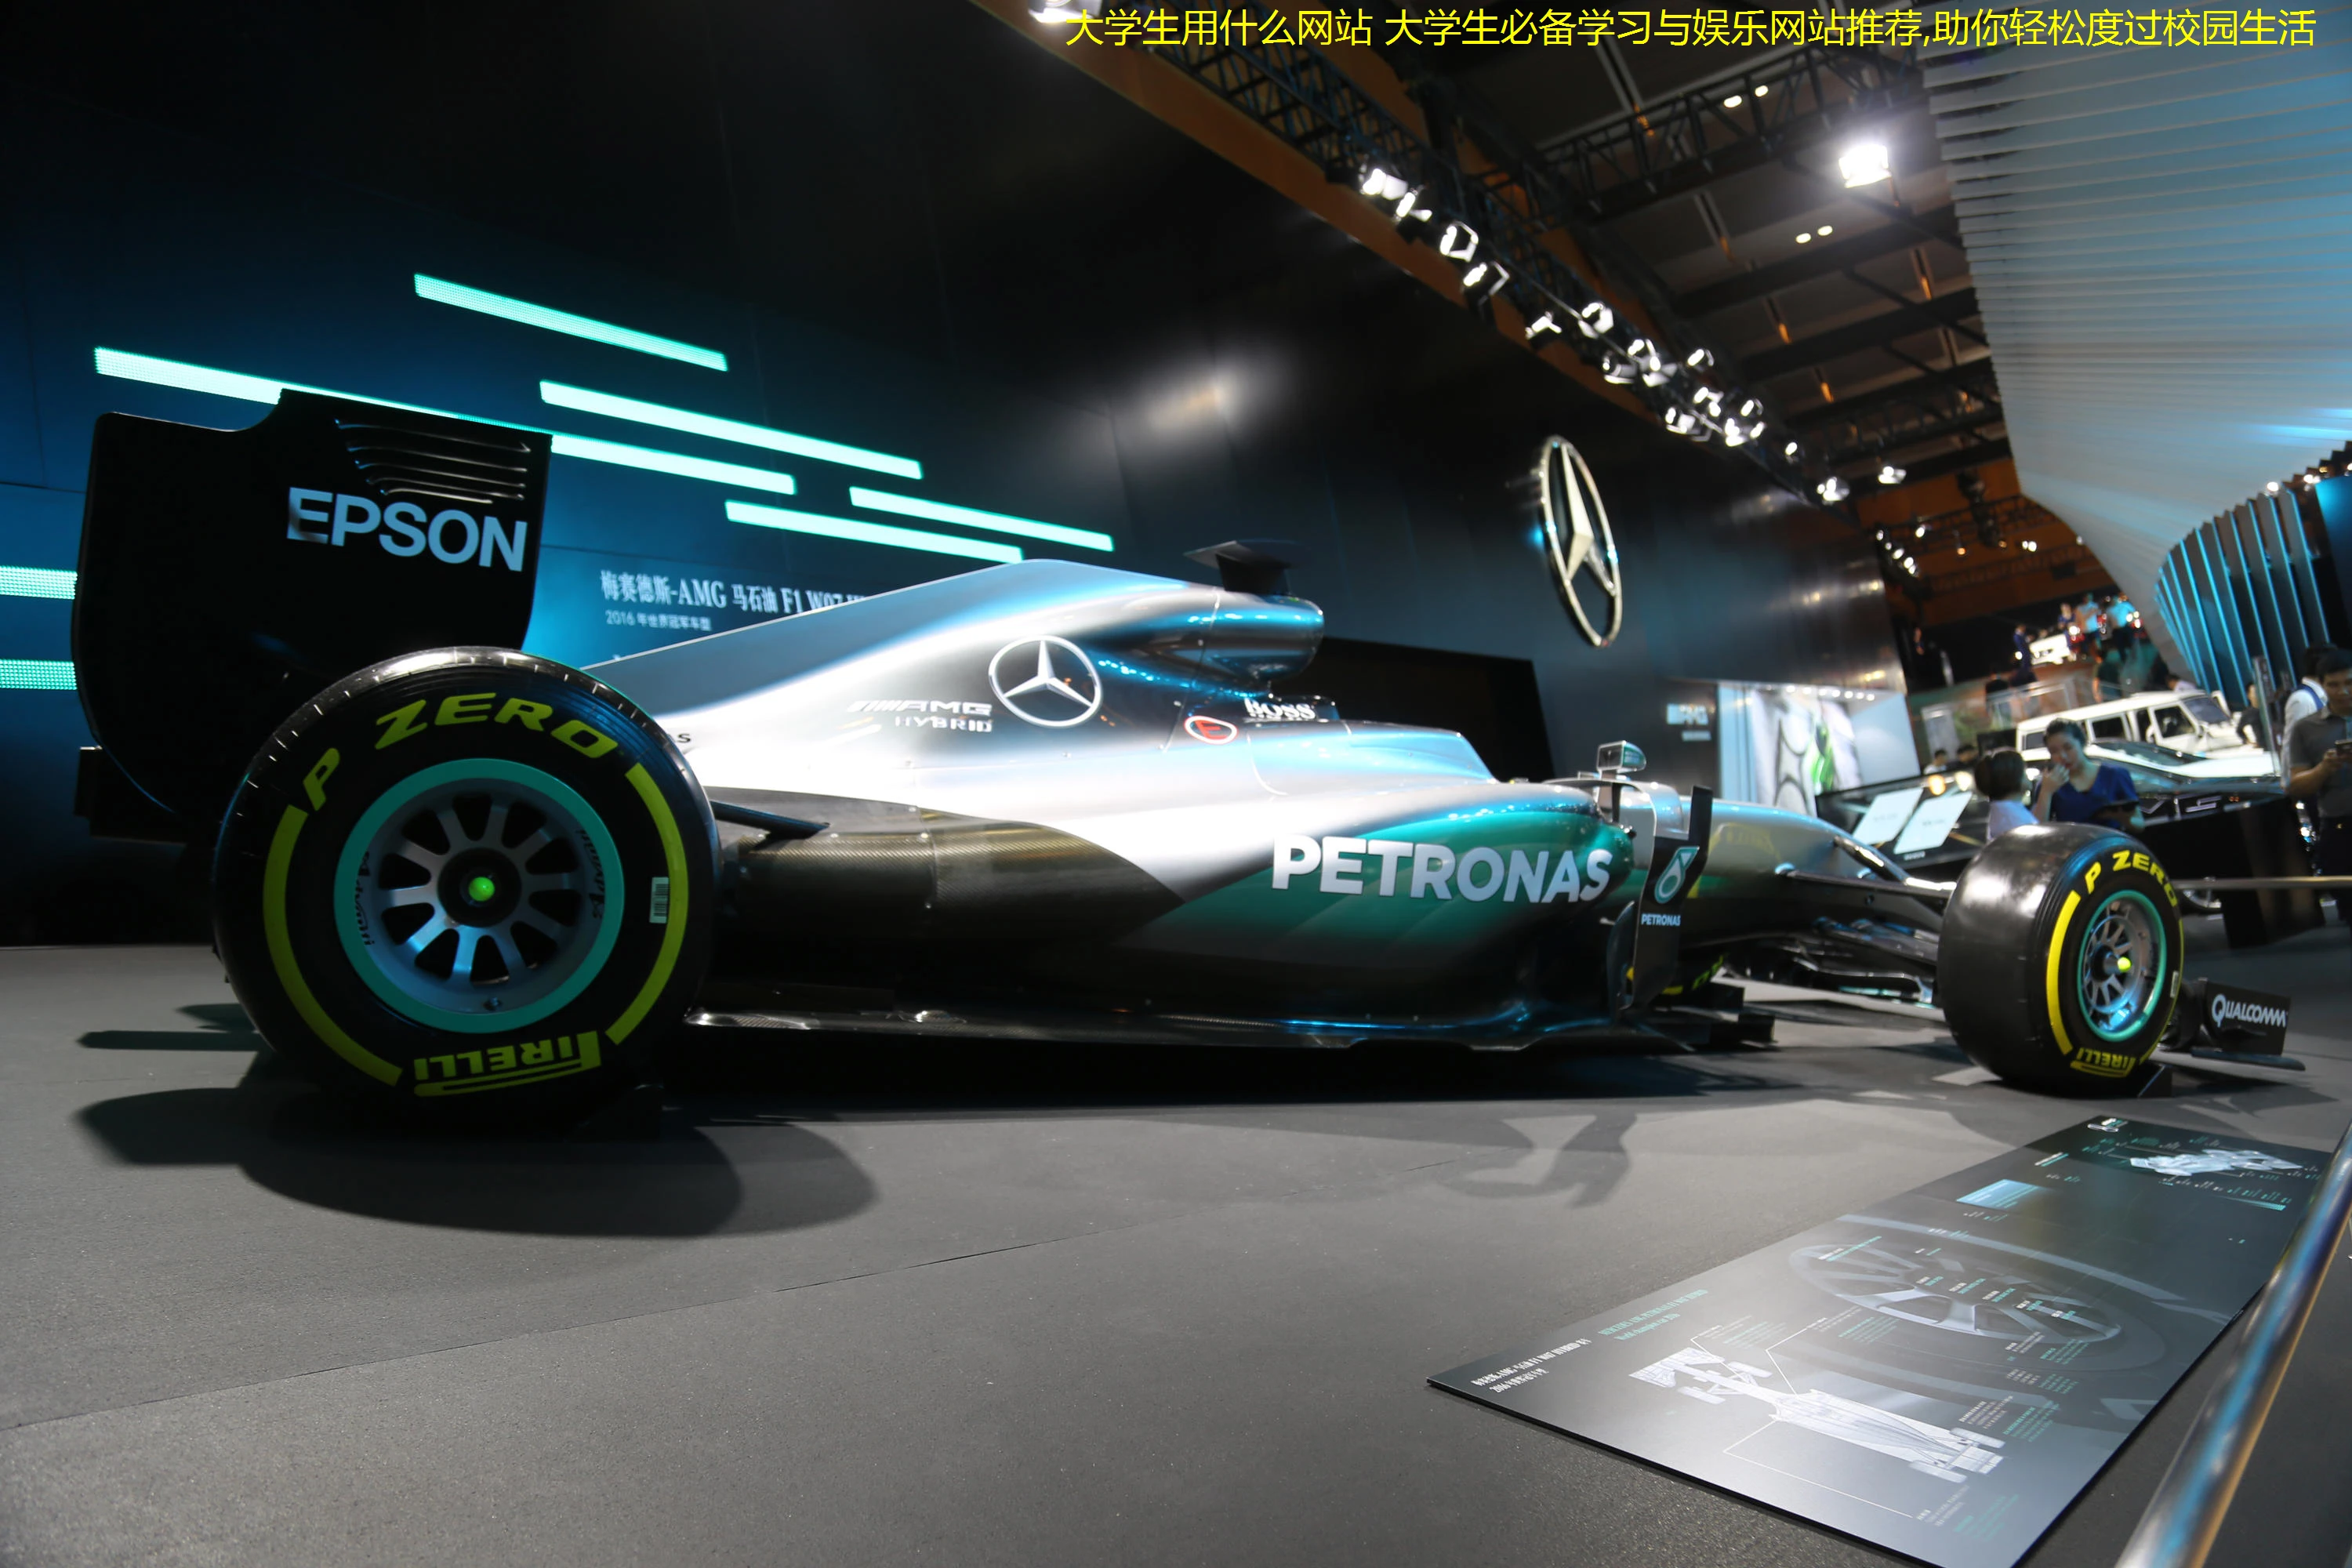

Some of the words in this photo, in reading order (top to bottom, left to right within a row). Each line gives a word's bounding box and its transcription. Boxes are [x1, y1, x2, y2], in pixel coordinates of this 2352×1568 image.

[287, 486, 528, 572] EPSON
[601, 570, 727, 608] 梅赛德斯-AMG
[732, 583, 779, 614] 马石油
[781, 587, 802, 613] F1
[605, 609, 636, 626] 2016
[895, 716, 992, 732] HYBRID
[1243, 697, 1316, 720] BOSS
[303, 747, 340, 811] P
[374, 692, 618, 759] ZERO
[1272, 834, 1613, 903] PETRONAS
[2084, 862, 2102, 895] P
[2112, 849, 2178, 908] ZERO
[1641, 913, 1682, 927] PETRONAS
[2211, 993, 2287, 1028] QUALCOMM
[414, 1029, 602, 1098] PIRELLI
[2069, 1047, 2138, 1078] PIRELLI
